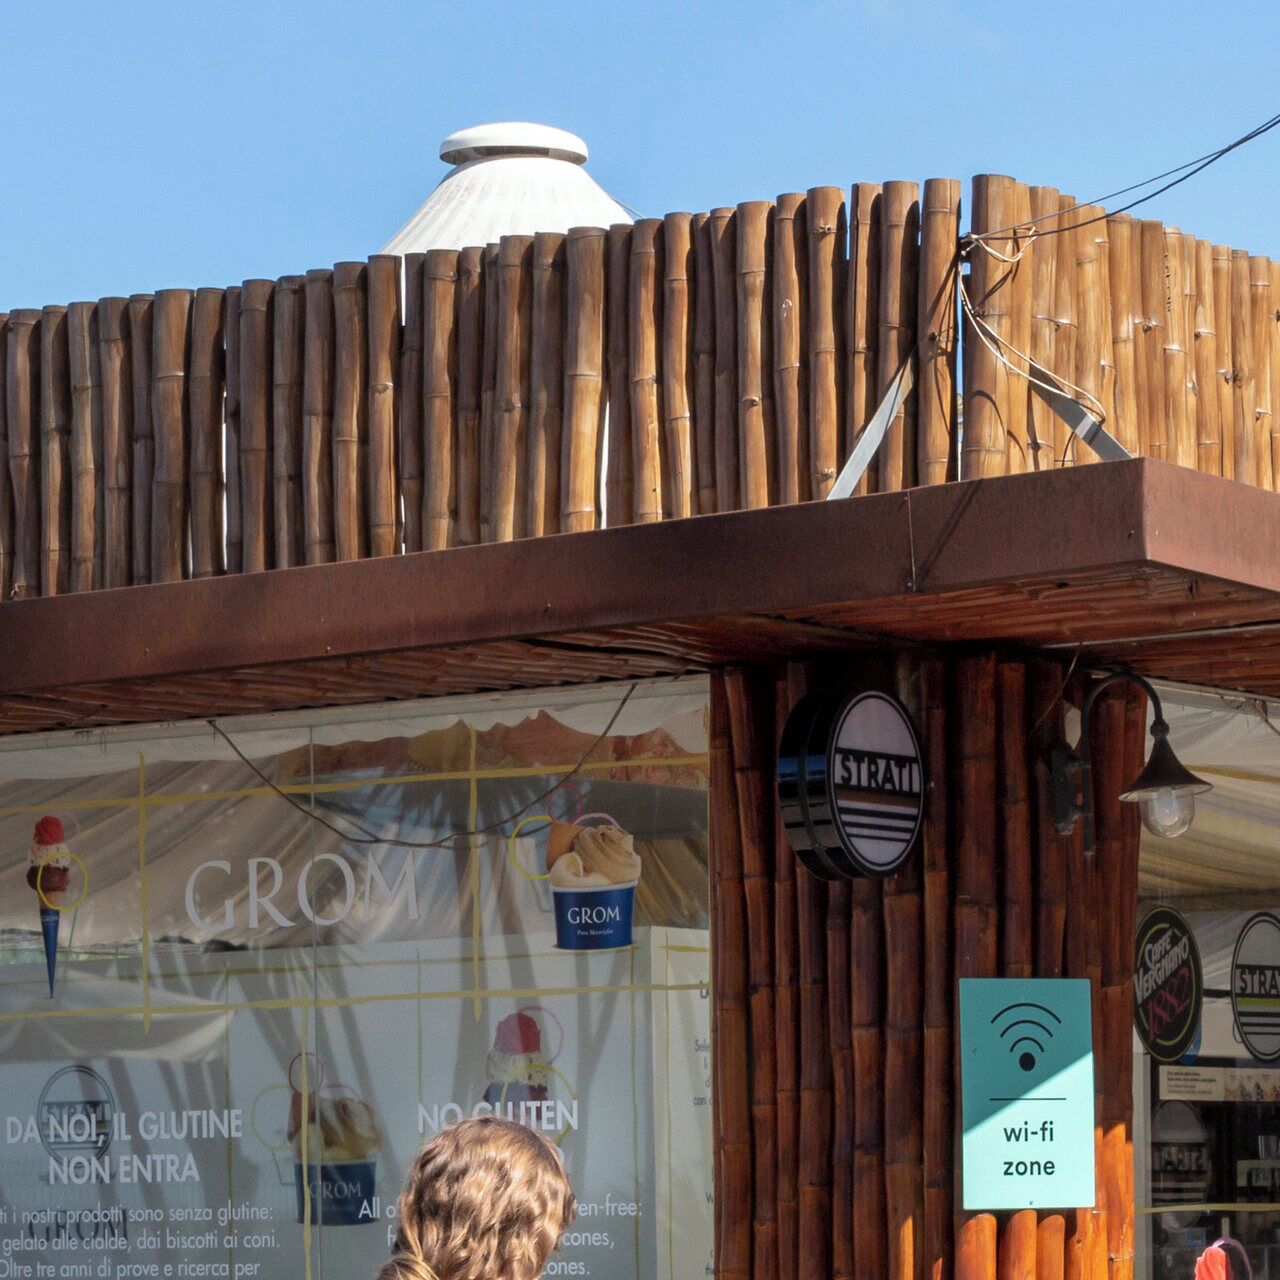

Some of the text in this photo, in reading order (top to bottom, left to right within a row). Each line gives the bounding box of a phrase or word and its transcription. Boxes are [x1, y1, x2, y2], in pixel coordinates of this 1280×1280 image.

[840, 752, 913, 792] STRATI
[184, 849, 420, 935] GROM
[567, 905, 620, 924] GROM
[1134, 935, 1189, 1005] VERGNANO
[6, 1109, 243, 1147] DA NOI, IL GLUTINE
[418, 1102, 463, 1133] NO
[1003, 1120, 1054, 1142] wi-fi
[49, 1155, 110, 1185] NON
[119, 1153, 200, 1184] ENTRA
[1003, 1160, 1055, 1176] zone
[22, 1203, 62, 1225] nostri
[66, 1202, 122, 1231] prodotti
[129, 1206, 164, 1222] sono
[169, 1206, 213, 1222] senza
[218, 1199, 274, 1227] glutine:
[358, 1196, 380, 1218] All
[3, 1232, 48, 1257] gelato
[52, 1229, 79, 1250] alle
[83, 1228, 132, 1253] cialde,
[136, 1228, 161, 1250] dai
[166, 1226, 218, 1249] biscotti
[223, 1228, 239, 1249] ai
[243, 1226, 280, 1249] coni.
[36, 1261, 56, 1278] tre
[60, 1259, 92, 1278] anni
[98, 1257, 112, 1278] di
[163, 1263, 173, 1277] e
[178, 1259, 229, 1277] ricerca
